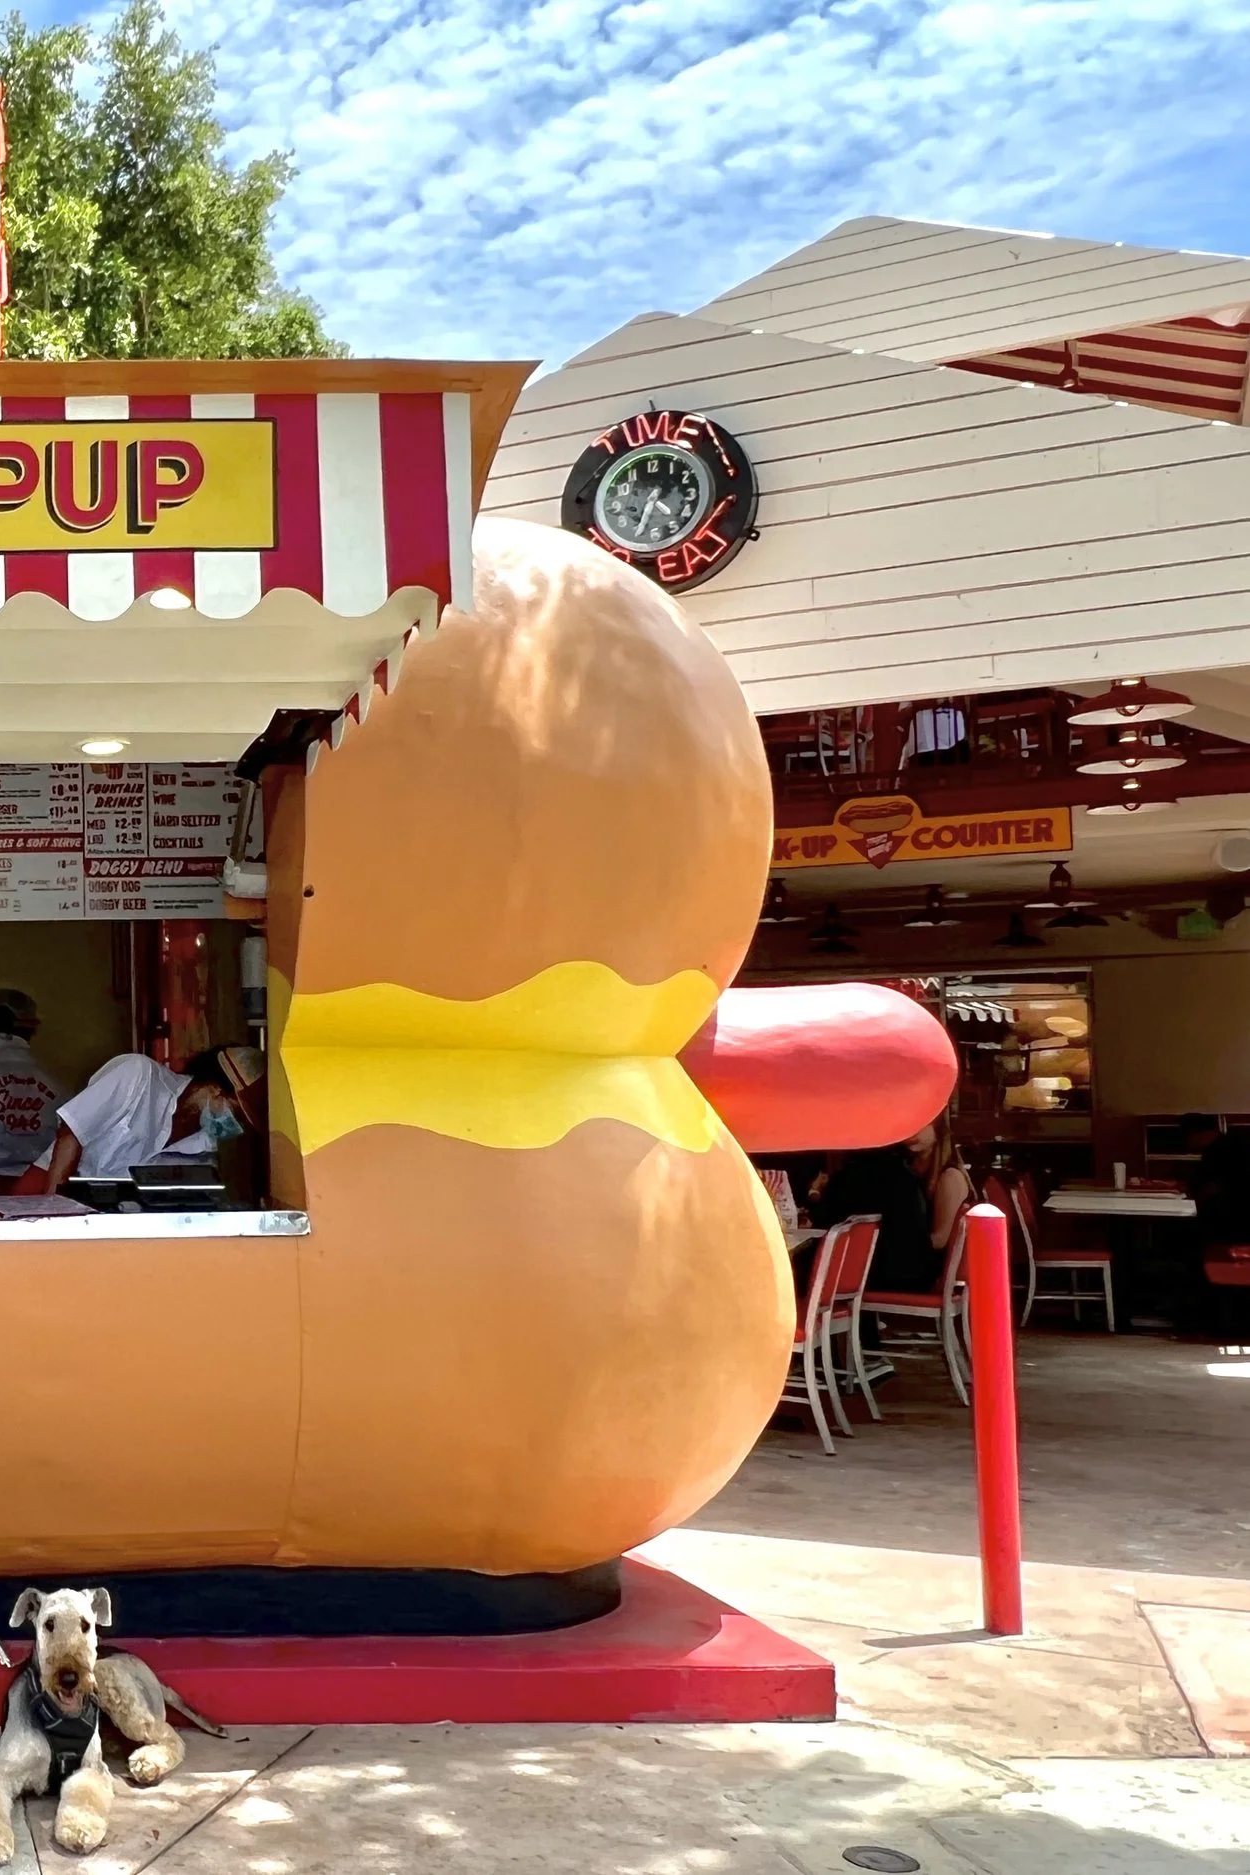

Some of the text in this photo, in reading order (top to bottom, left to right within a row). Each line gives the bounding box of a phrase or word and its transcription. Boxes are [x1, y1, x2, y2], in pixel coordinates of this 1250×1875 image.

[592, 411, 706, 454] TIME
[647, 460, 659, 474] 12
[627, 468, 637, 482] 11
[682, 471, 690, 484] 2
[617, 485, 630, 497] 10
[686, 488, 697, 501] 3
[611, 501, 622, 514] 9
[681, 504, 692, 517] 4
[617, 516, 628, 528] 8
[669, 521, 680, 534] 5
[650, 527, 662, 541] 6
[657, 530, 728, 582] EAT
[86, 783, 145, 794] FOUNTAIN
[95, 796, 144, 808] DRINKS
[181, 814, 221, 827] SELTZER
[911, 817, 1055, 850] COUNTER
[26, 838, 49, 848] SOFT
[50, 838, 83, 848] SERVE
[153, 837, 204, 849] COCKTAILS
[88, 860, 139, 875] DOGGY
[141, 860, 184, 874] MENU
[88, 881, 120, 893] DOGGY
[121, 881, 141, 892] DOG
[122, 898, 146, 910] BEER
